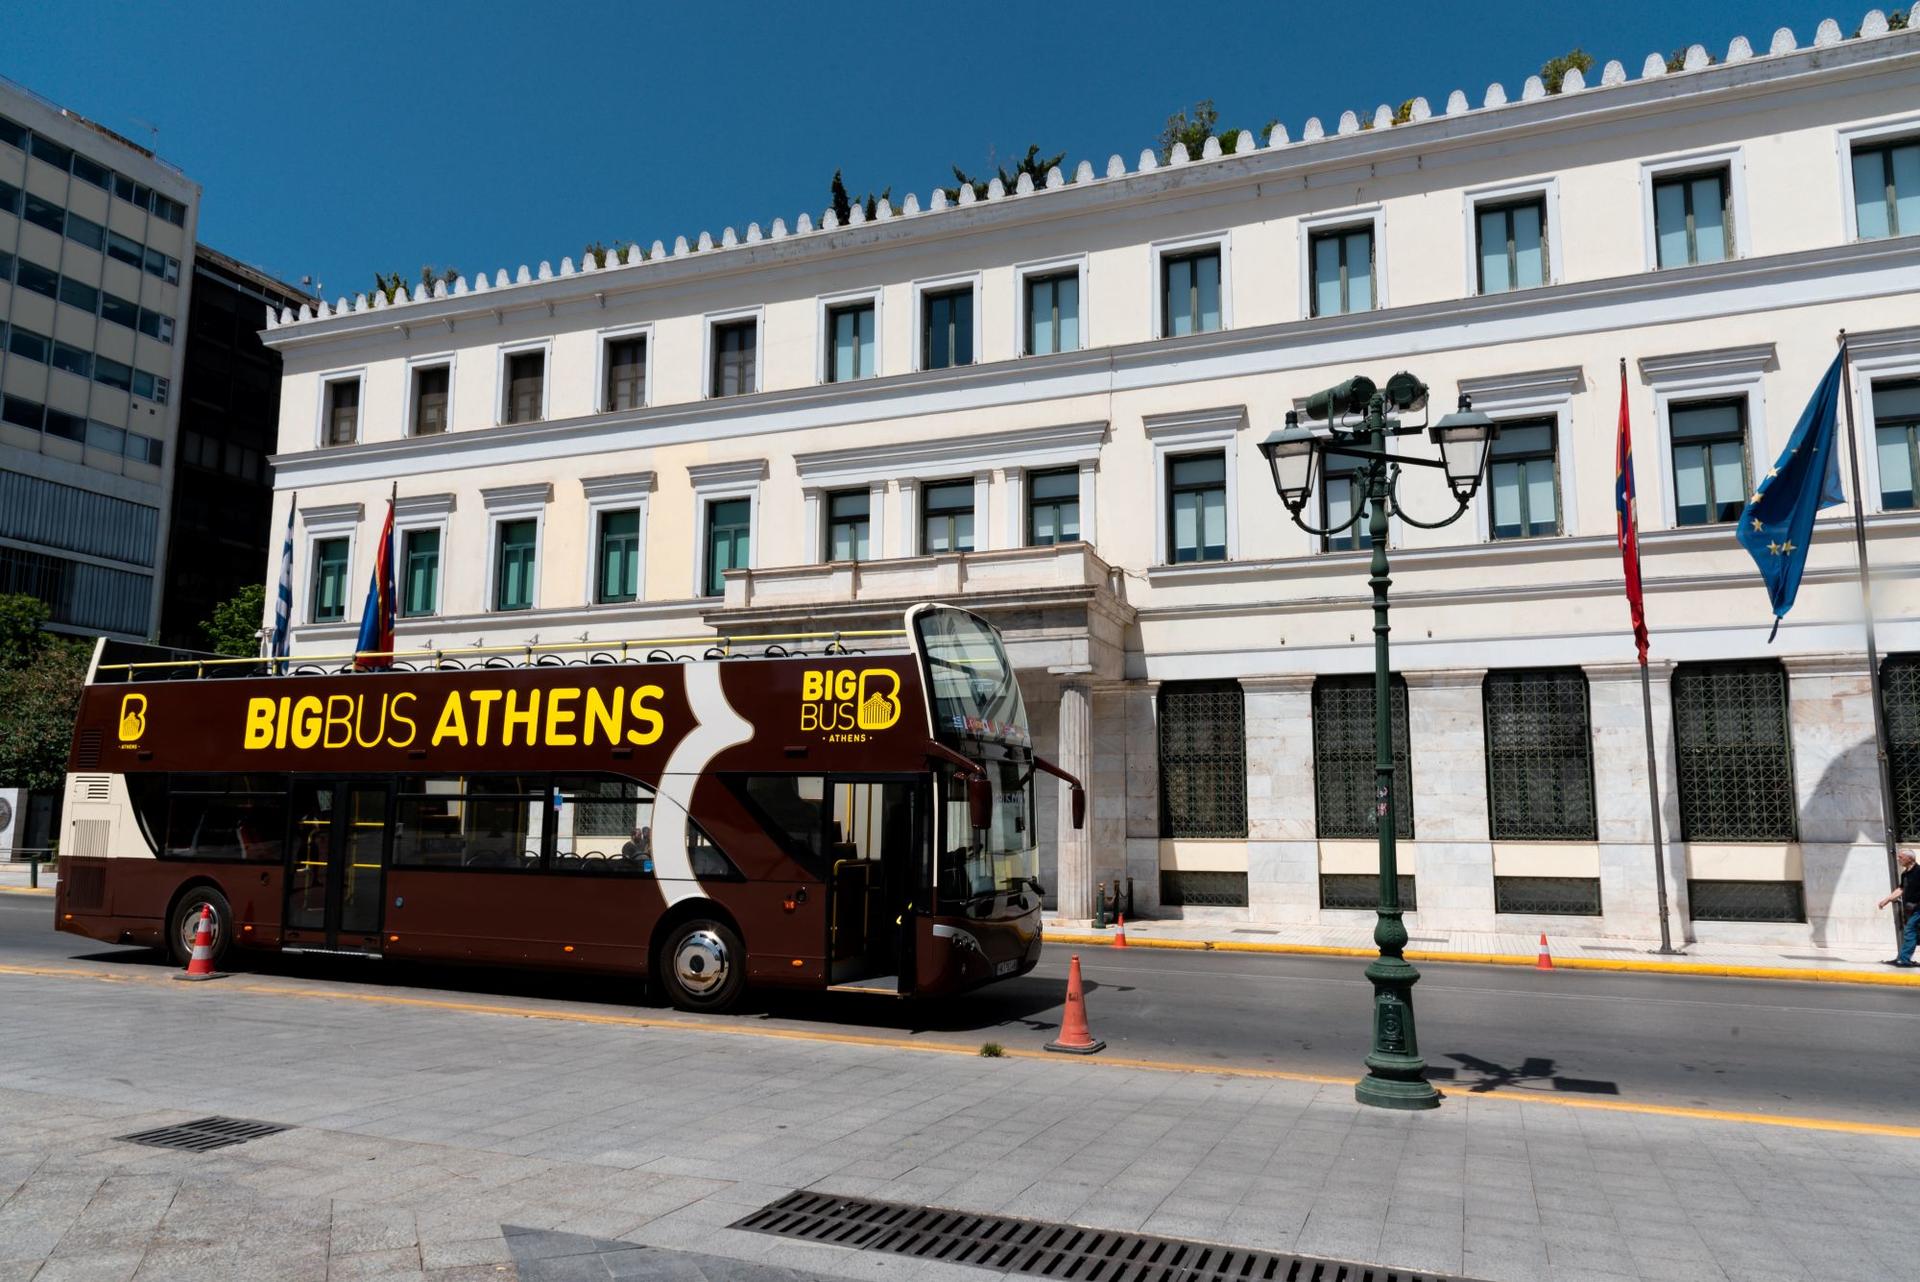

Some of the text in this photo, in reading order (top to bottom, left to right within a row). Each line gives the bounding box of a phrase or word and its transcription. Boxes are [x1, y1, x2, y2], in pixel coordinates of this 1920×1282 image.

[803, 669, 857, 702] BIG
[431, 685, 665, 747] ATHENS
[800, 702, 855, 731] BUS
[828, 733, 867, 743] ATHENS
